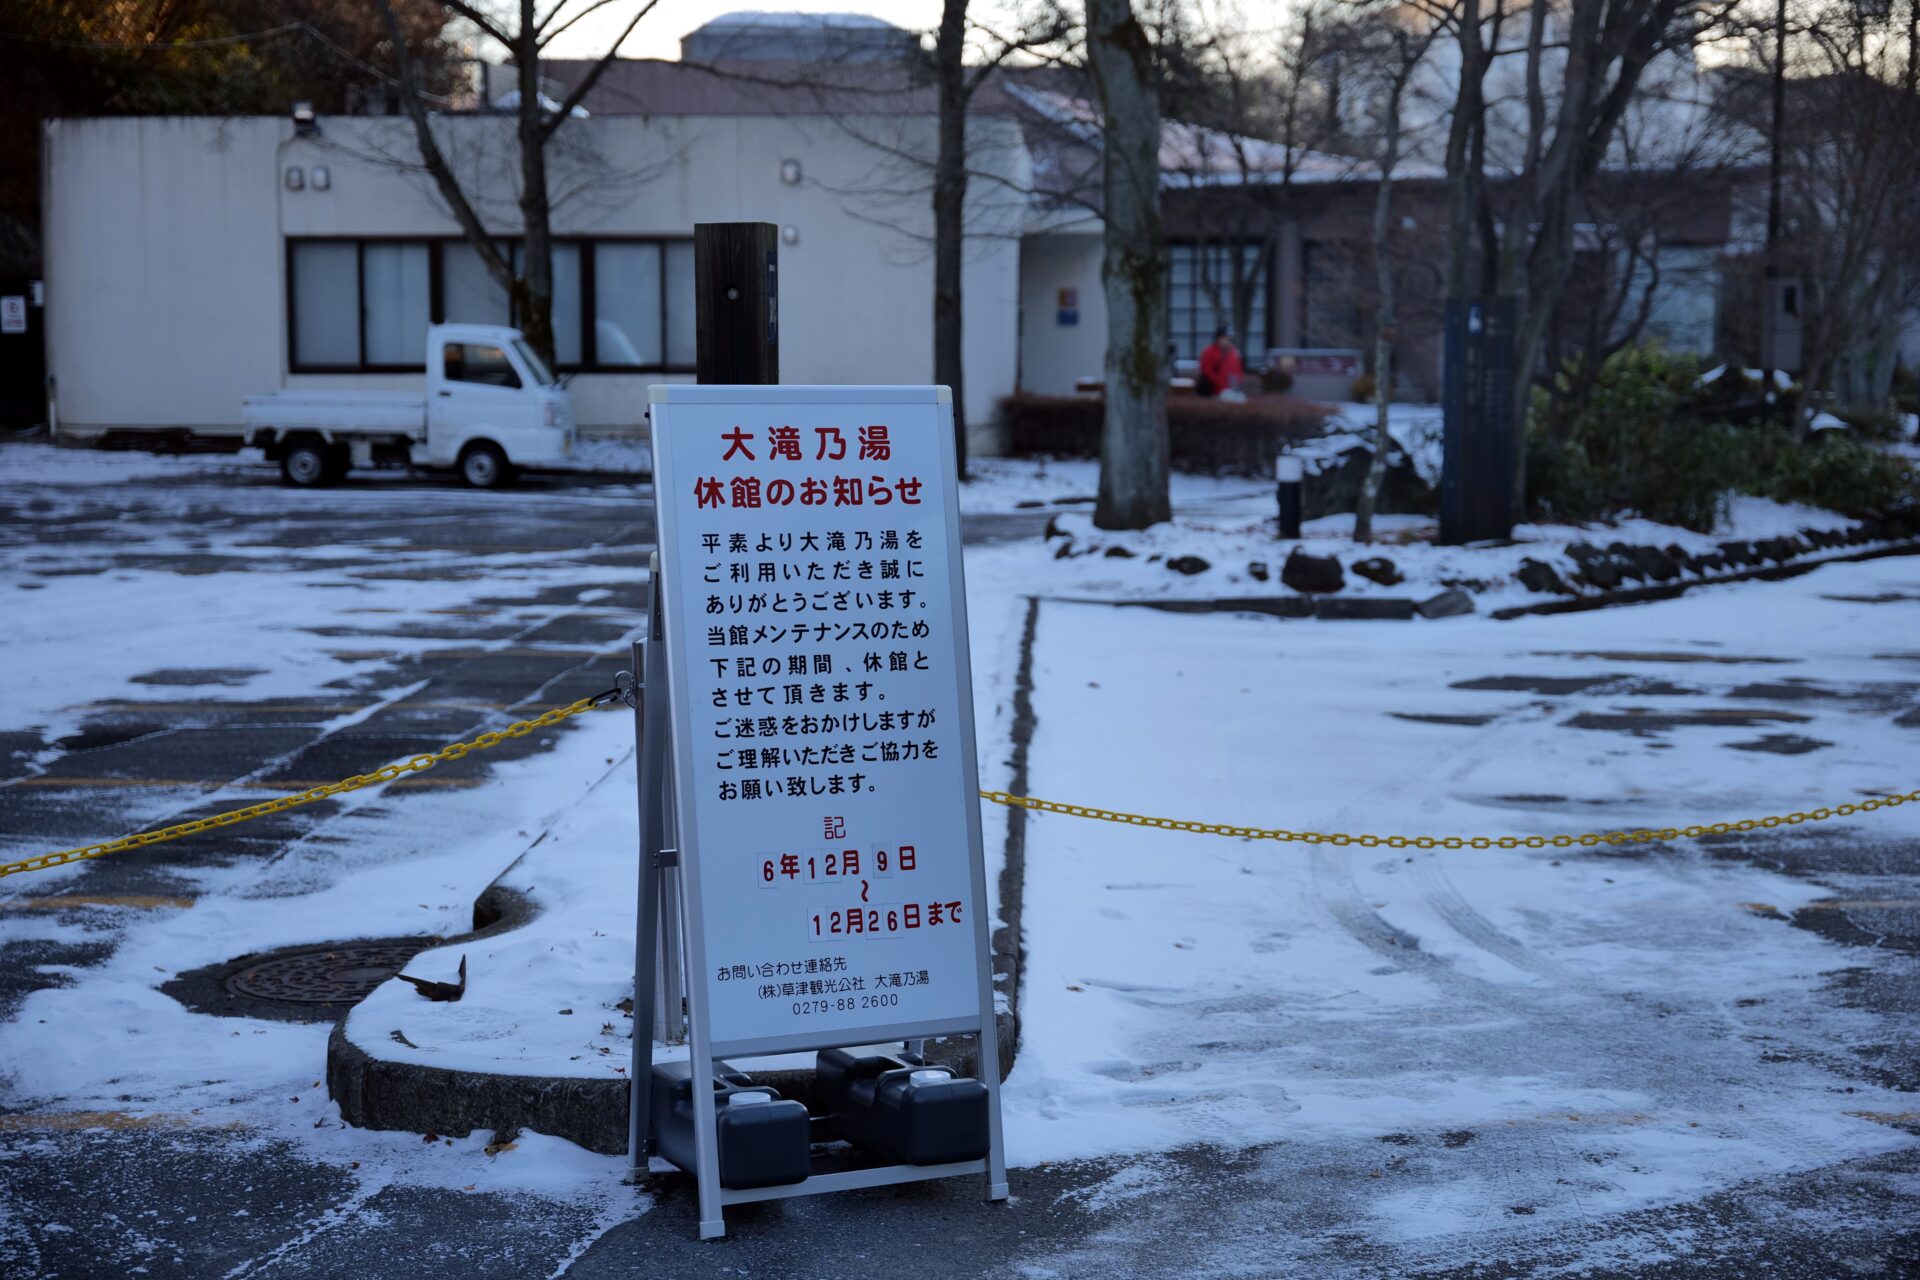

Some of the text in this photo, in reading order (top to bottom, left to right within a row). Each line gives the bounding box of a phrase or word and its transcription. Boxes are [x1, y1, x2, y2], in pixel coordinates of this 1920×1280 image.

[720, 425, 891, 462] 大滝乃湯
[693, 475, 923, 509] 休館のお知らせ
[701, 529, 923, 554] 平素より大滝乃湯を
[703, 559, 925, 583] ご利用いただき誠に
[705, 588, 927, 614] ありがとうございます。
[707, 620, 930, 646] 当館メンテナンスのため
[709, 650, 930, 678] 下記の期間、休館と
[711, 681, 887, 707] させて頂きます。
[714, 708, 936, 739] ご迷惑をおかけしますが
[716, 739, 939, 770] ご理解いただきご協力を
[718, 773, 877, 801] お願い致します。
[823, 816, 847, 840] 記
[717, 956, 848, 982] お問い合わせ連絡先
[757, 970, 930, 1000] (株)草津観光公社 大滝乃湯
